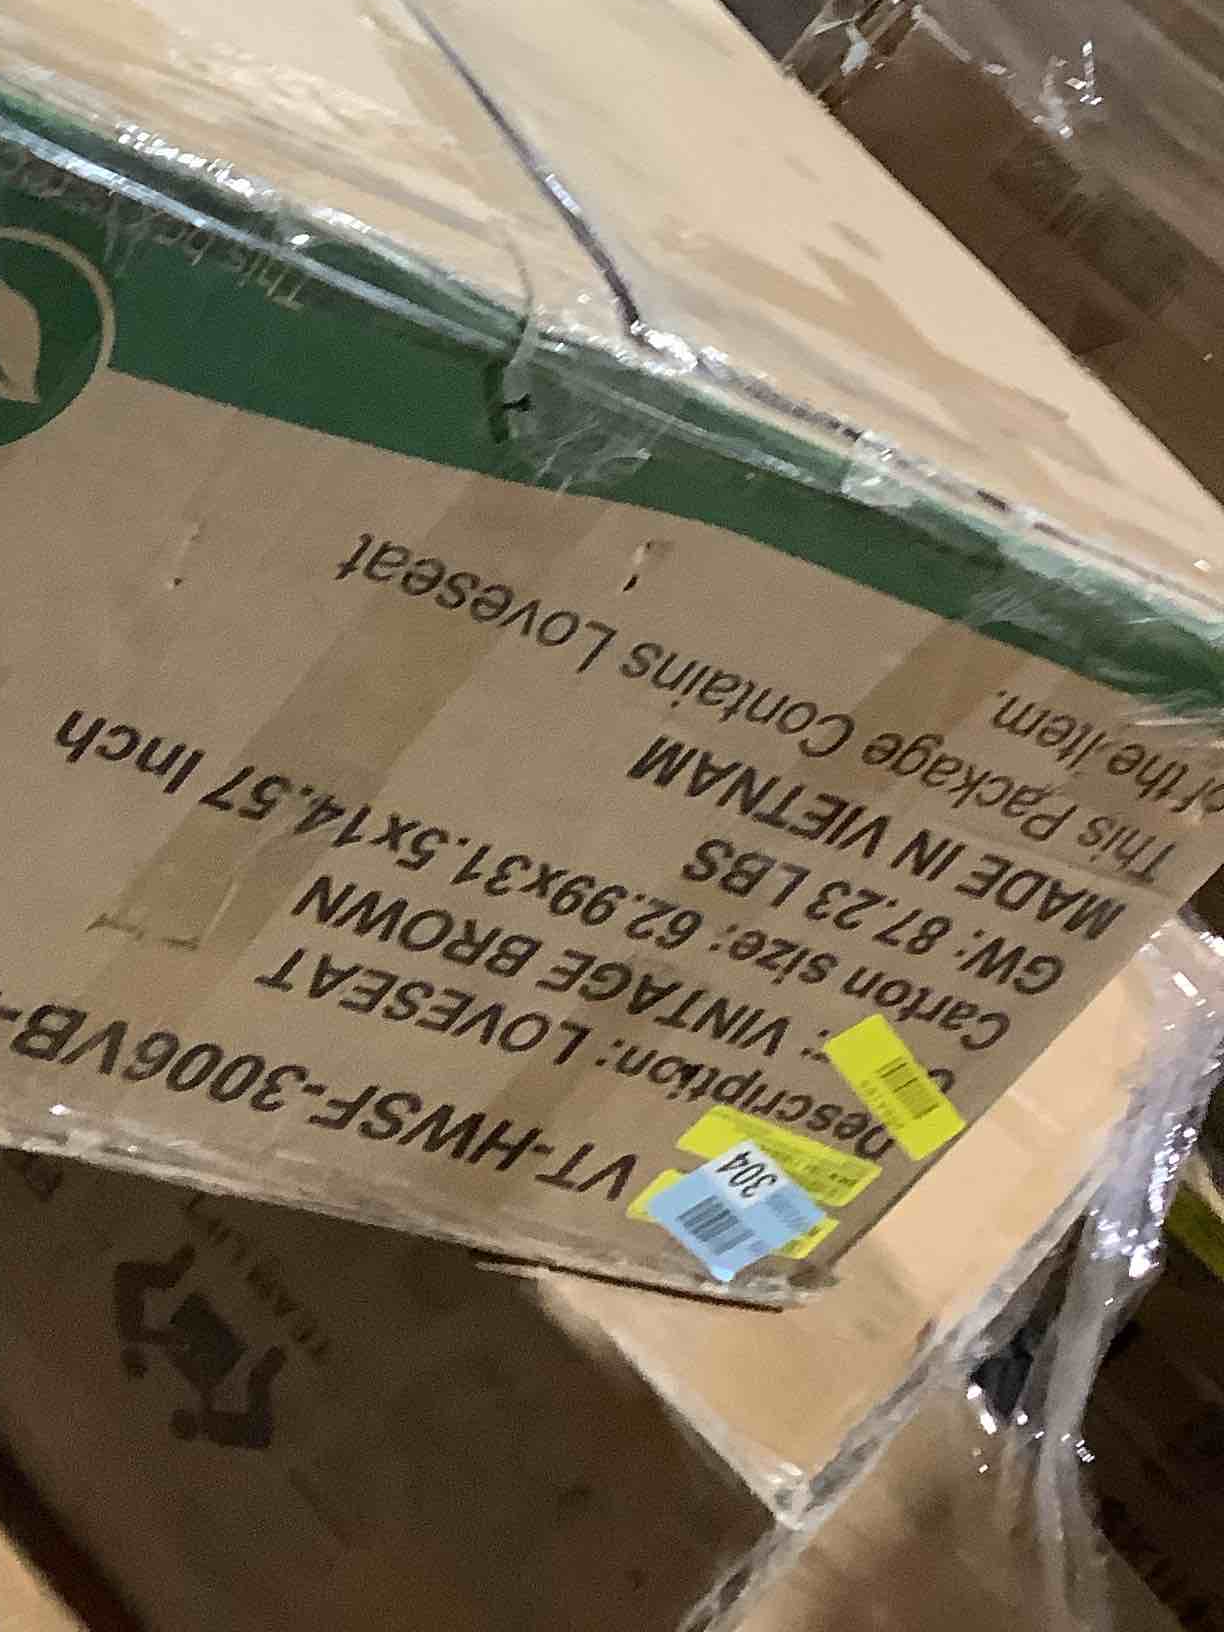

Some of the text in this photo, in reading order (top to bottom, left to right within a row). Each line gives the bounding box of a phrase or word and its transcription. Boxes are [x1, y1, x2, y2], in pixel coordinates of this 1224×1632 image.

[335, 532, 1176, 885] This Package Contains Loveseat
[1107, 743, 1188, 800] the
[54, 709, 1010, 1051] Carton size: 62.99x31.5x14.57 Inch
[626, 734, 1127, 941] MADE IN VIETNAM
[681, 838, 1065, 995] GW: 87.23 LBS
[253, 947, 594, 1065] LOVESEAT
[290, 873, 792, 1057] VINTAGE BROWN
[716, 1150, 777, 1198] 304
